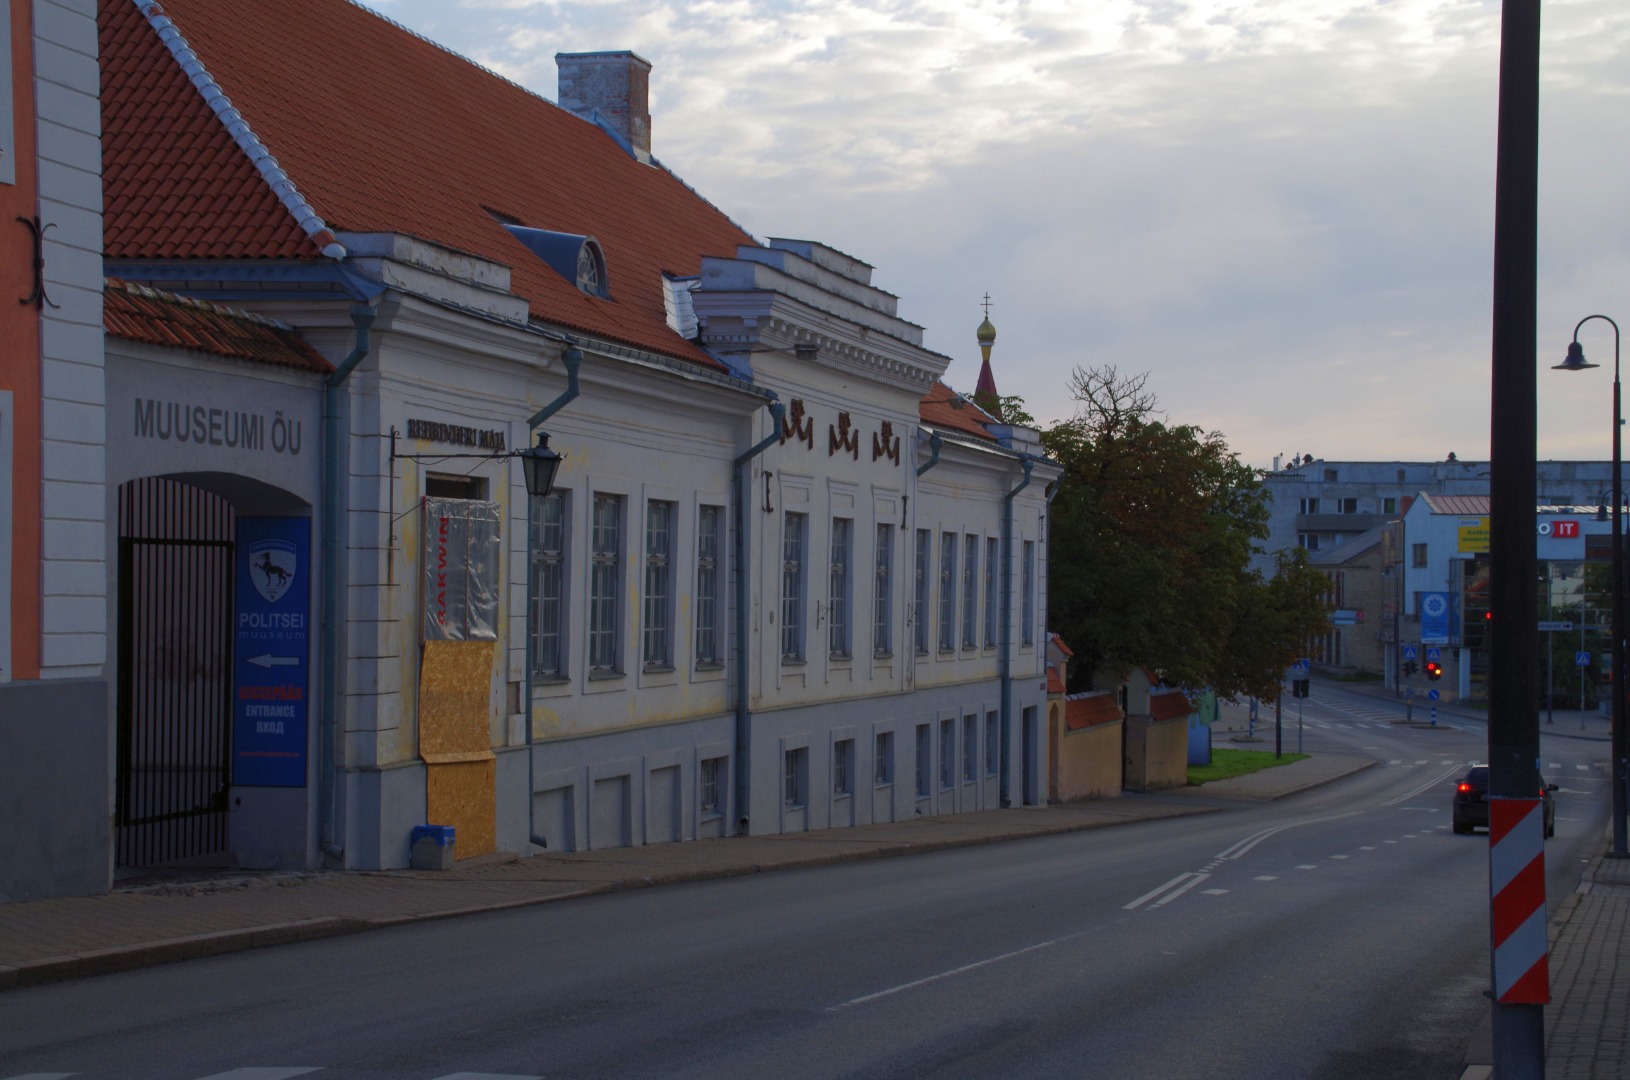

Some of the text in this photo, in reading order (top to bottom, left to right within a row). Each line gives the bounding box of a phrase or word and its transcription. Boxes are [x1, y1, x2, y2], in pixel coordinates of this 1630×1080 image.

[134, 397, 302, 456] MUUSEUMI ÕU
[1559, 523, 1574, 535] IT
[239, 612, 304, 628] POLITSEI
[238, 631, 305, 640] muuseum
[245, 704, 295, 717] ENTRANCE
[256, 721, 285, 735] ВХОД
